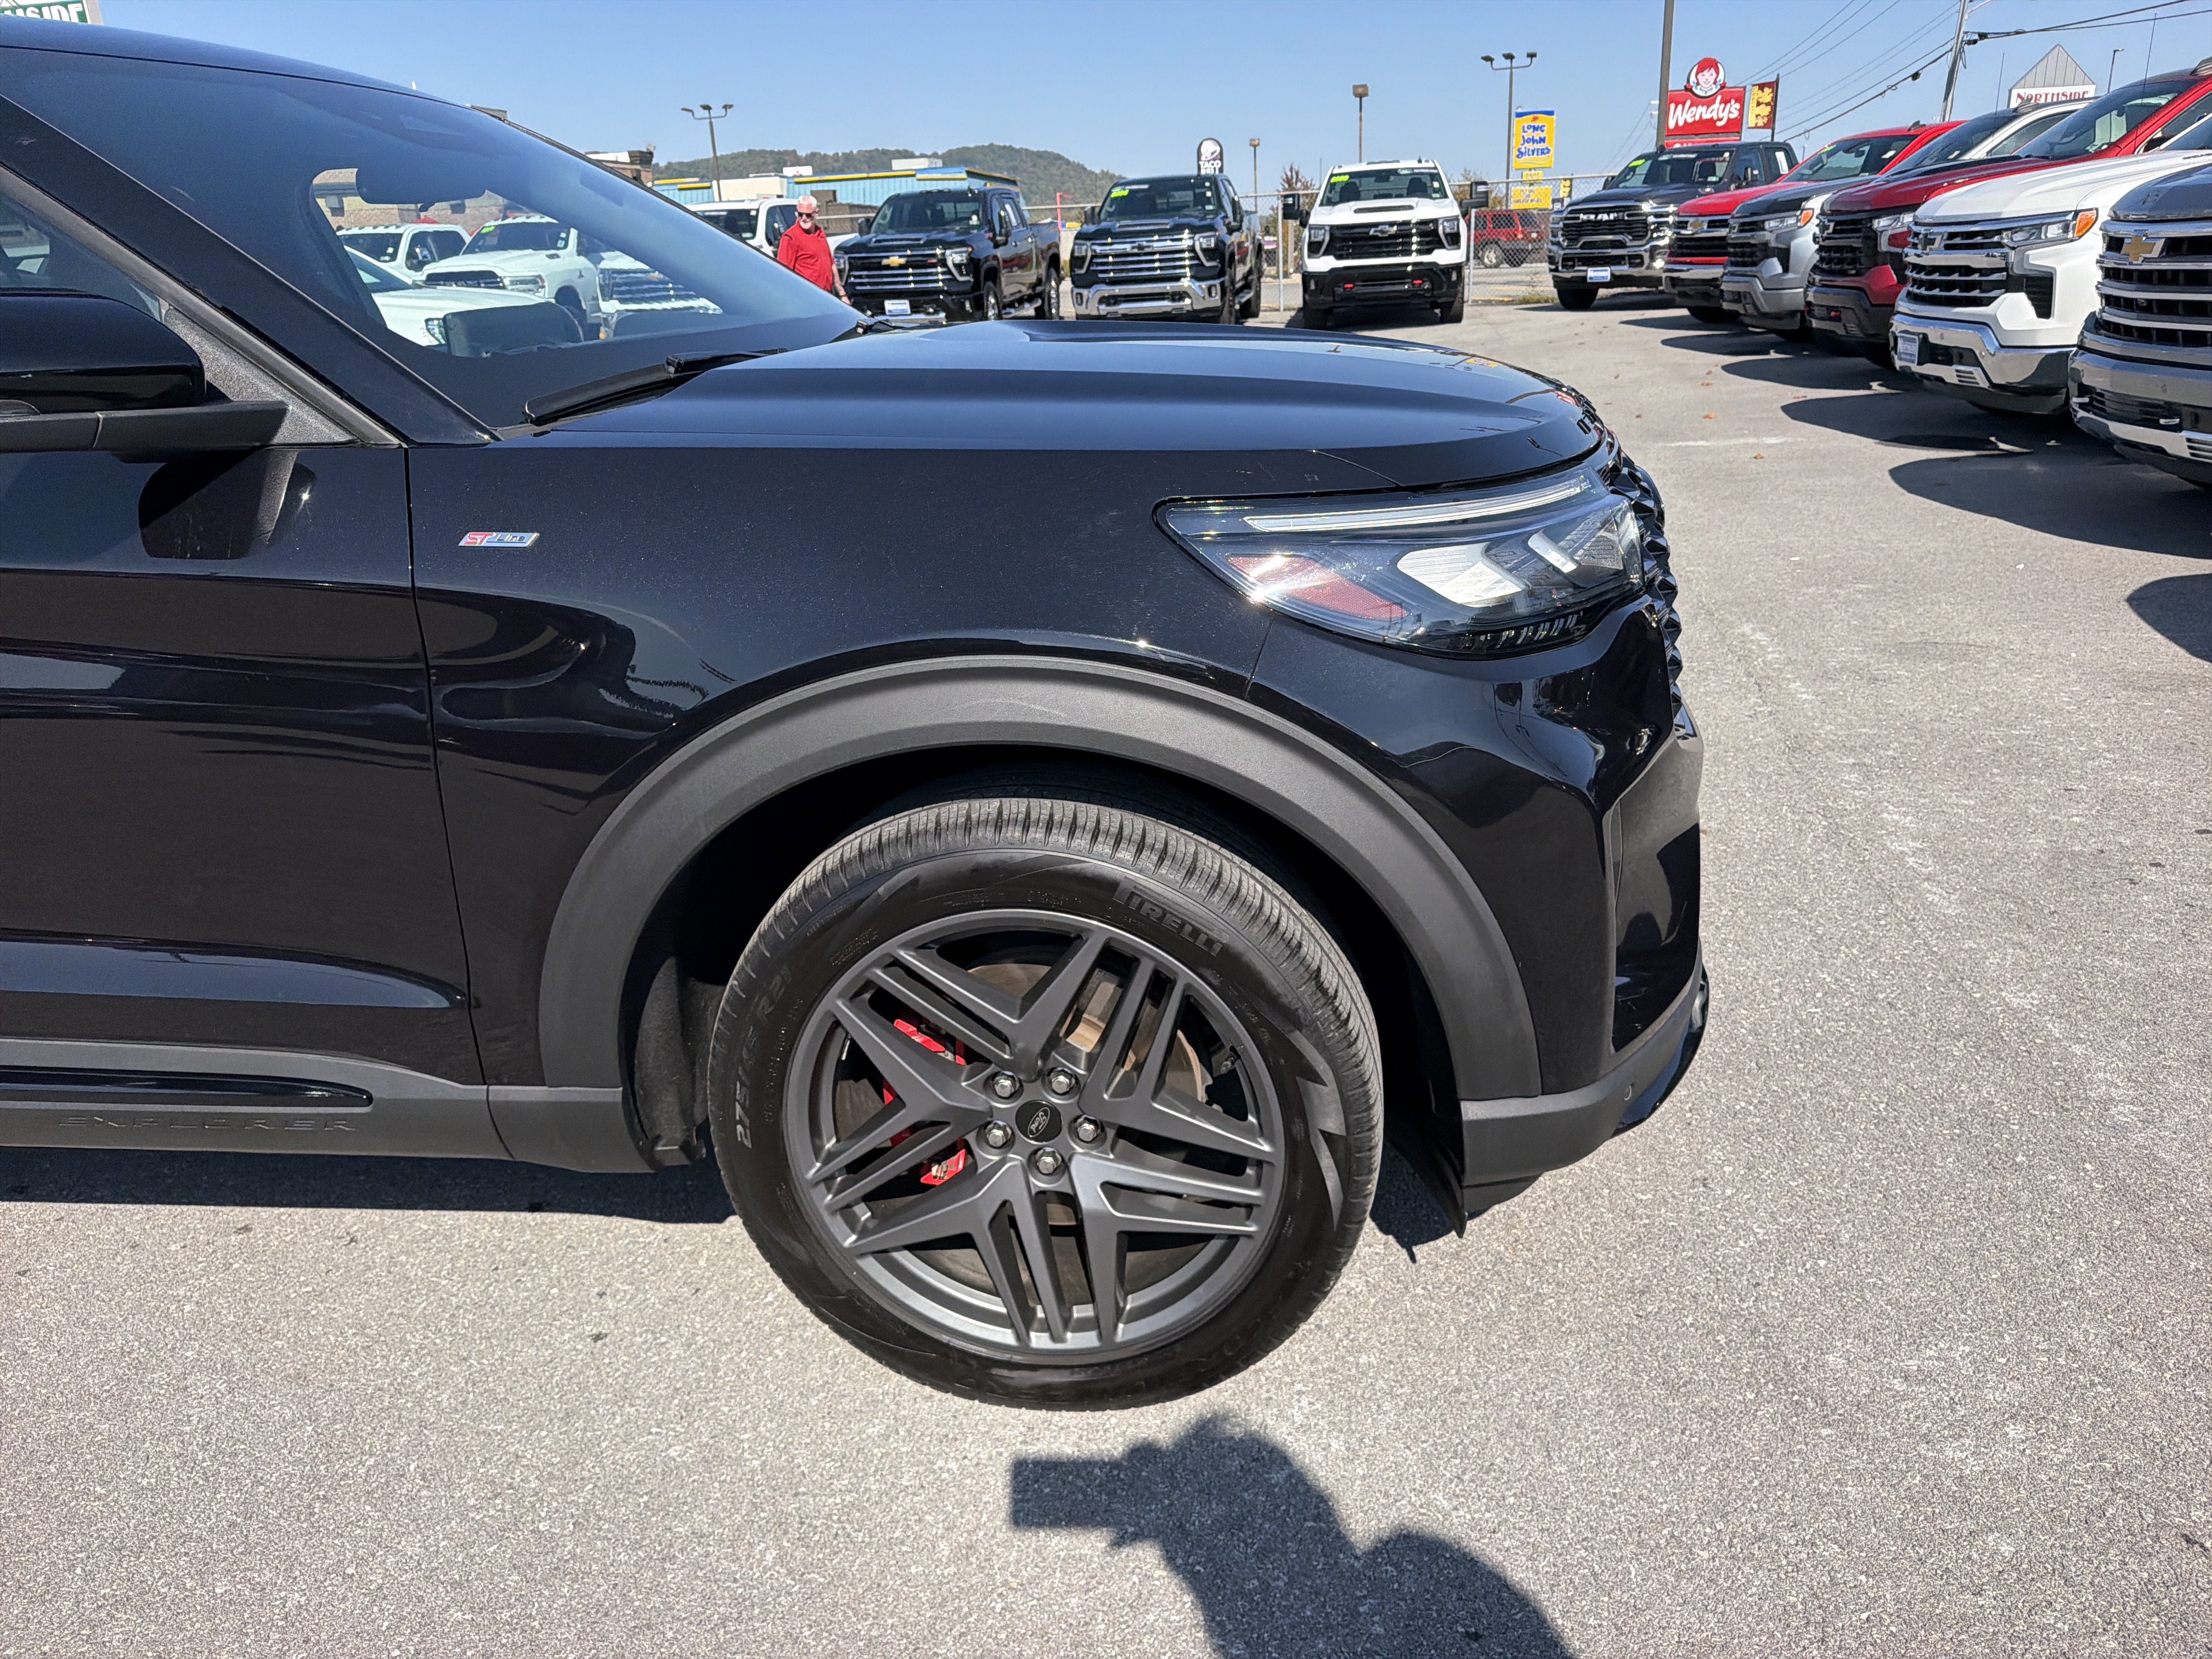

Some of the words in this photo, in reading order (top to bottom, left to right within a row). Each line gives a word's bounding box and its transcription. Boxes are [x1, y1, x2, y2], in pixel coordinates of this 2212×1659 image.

[1668, 94, 1740, 129] Wendy's
[1582, 212, 1624, 221] RAM
[1112, 876, 1229, 957] PIRELLI
[59, 1115, 357, 1131] EXPLORER
[1030, 1111, 1047, 1133] Ford
